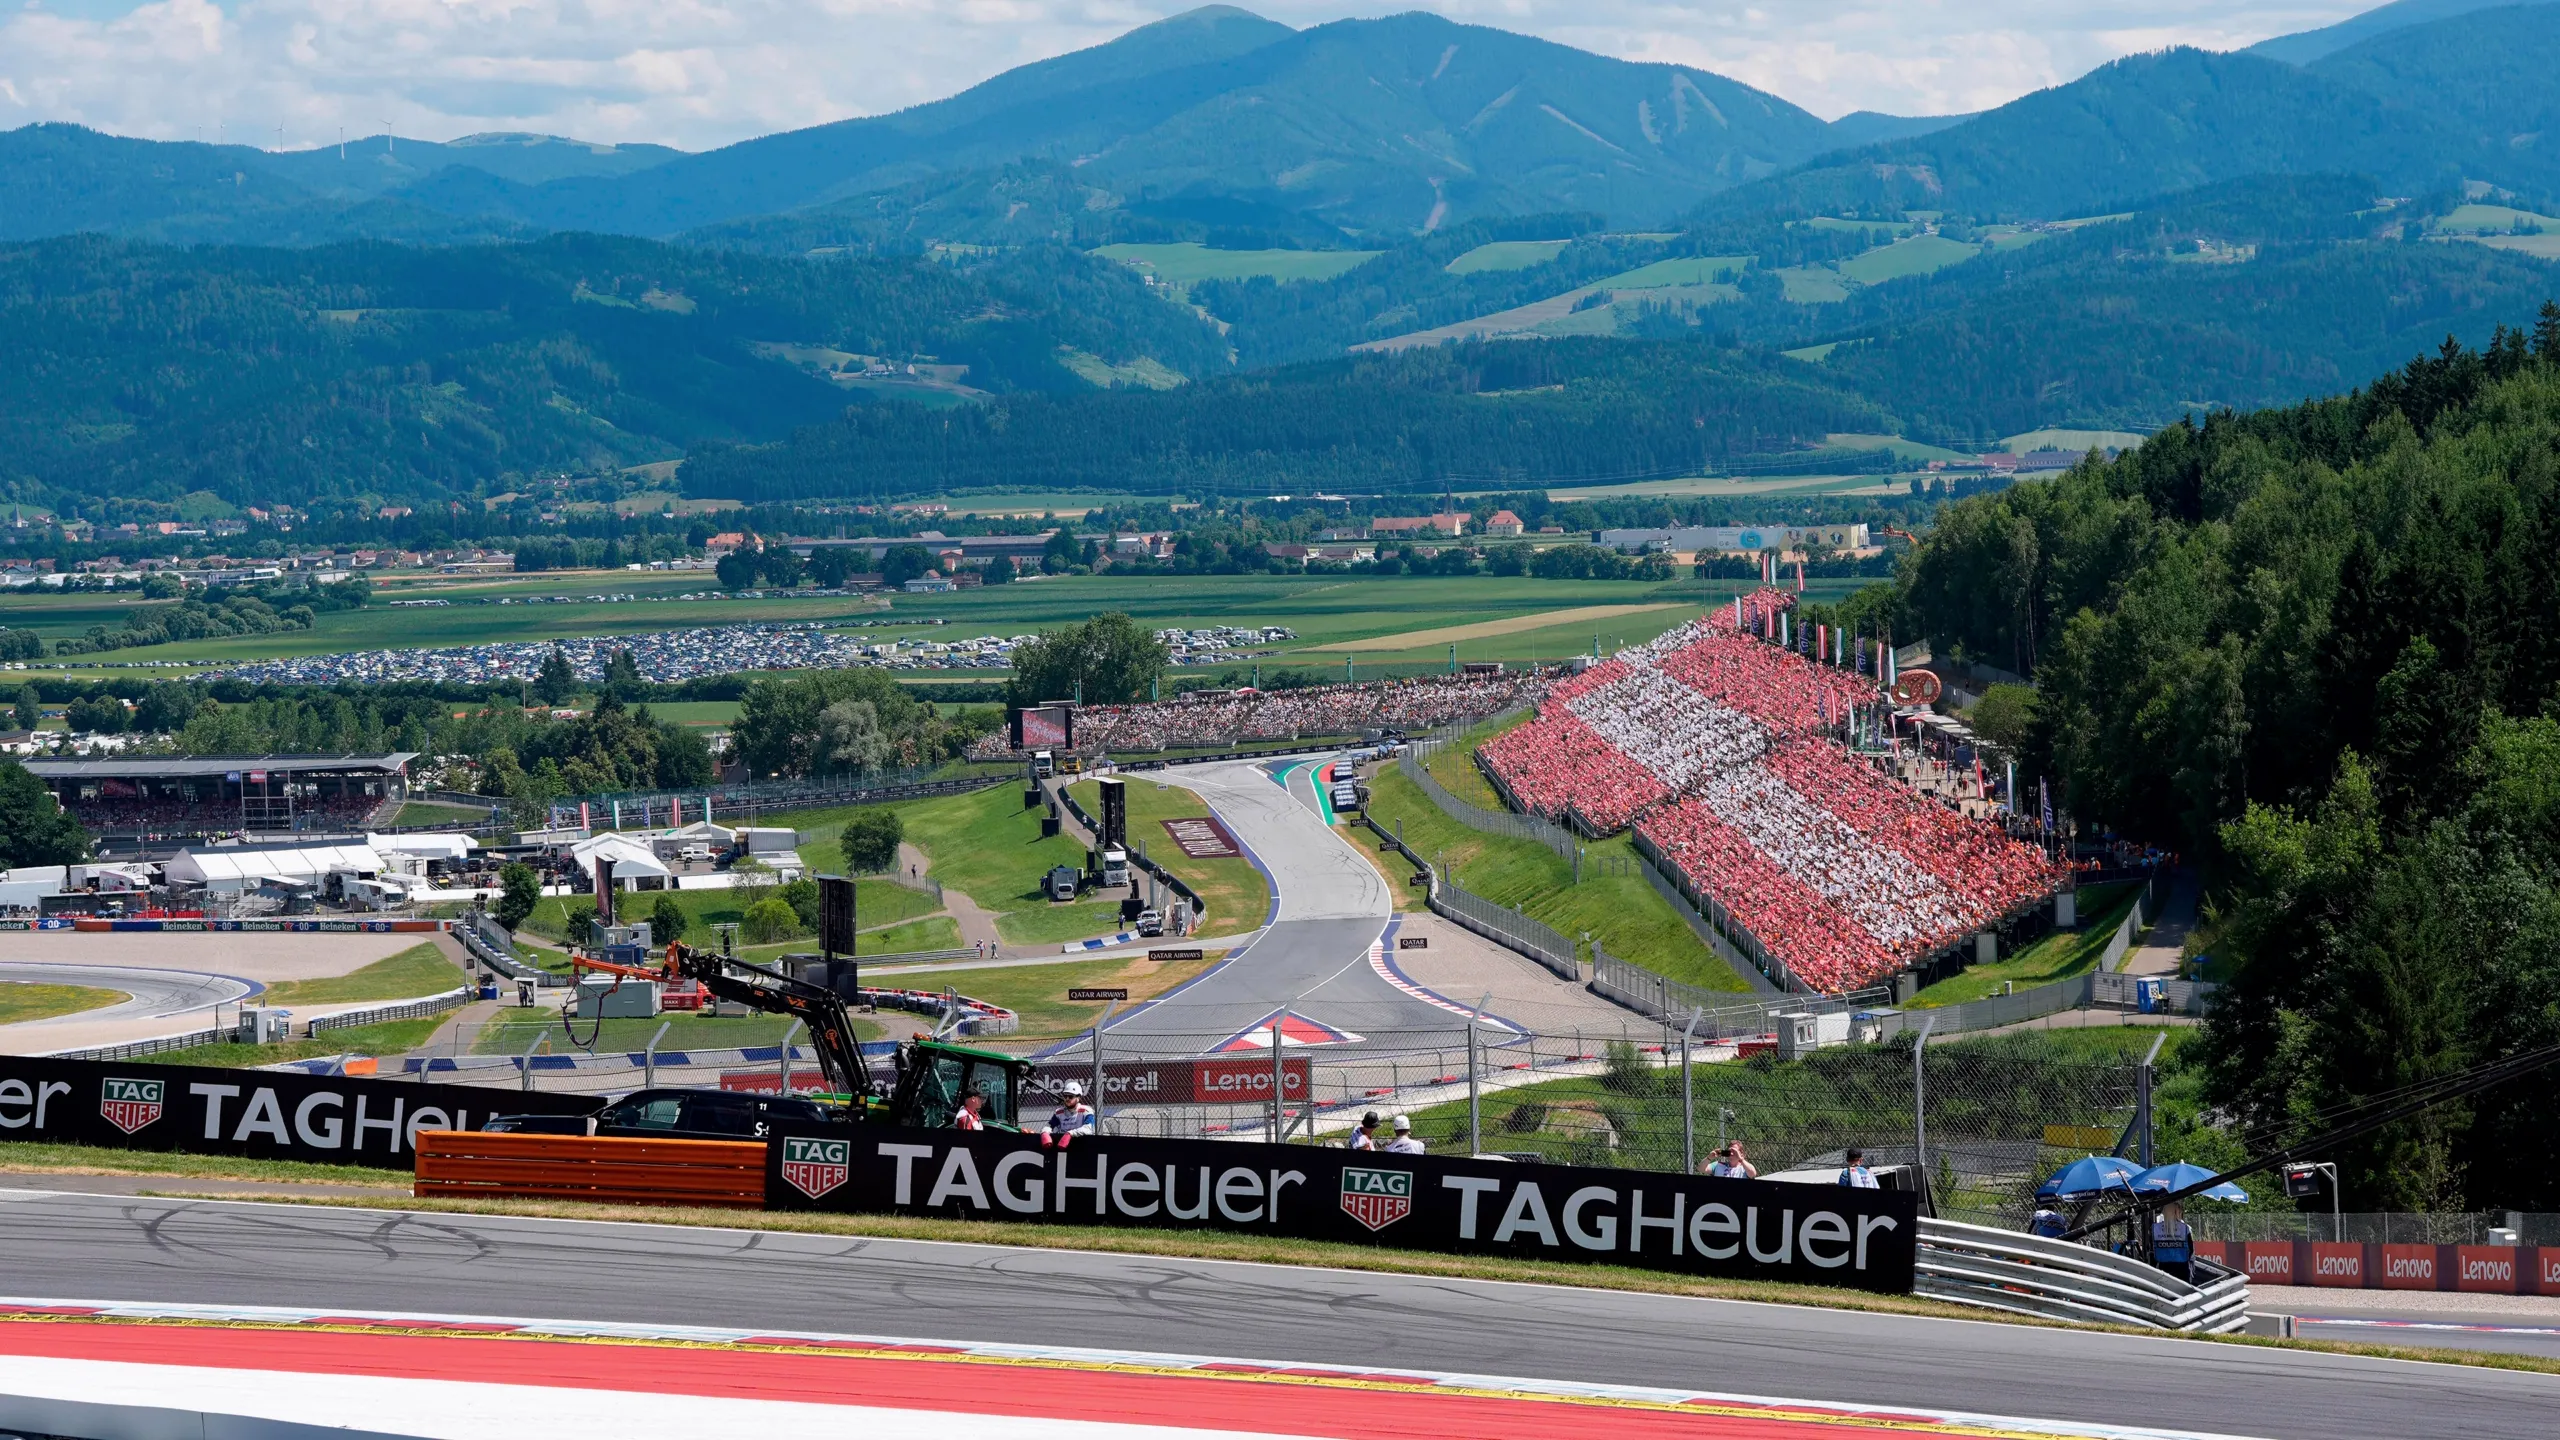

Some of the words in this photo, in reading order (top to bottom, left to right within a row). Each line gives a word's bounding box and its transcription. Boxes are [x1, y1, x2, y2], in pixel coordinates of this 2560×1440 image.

[162, 922, 203, 931] Heineken
[242, 922, 281, 931] Heineken
[320, 922, 357, 931] Heineken
[1150, 952, 1172, 960] QATAR
[1070, 991, 1094, 999] QATAR
[108, 1081, 158, 1100] TAG
[1101, 1071, 1131, 1091] for
[1135, 1071, 1158, 1091] all
[1204, 1070, 1301, 1091] Lenovo
[104, 1103, 158, 1130] HEUER
[759, 1103, 767, 1111] 11
[790, 1141, 843, 1162] TAG
[785, 1163, 846, 1194] HEUER
[1347, 1171, 1405, 1195] TAG
[1344, 1195, 1407, 1226] HEUER
[2248, 1251, 2289, 1274] Lenovo
[2316, 1252, 2358, 1276] Lenovo
[2387, 1254, 2432, 1278] Lenovo
[2462, 1255, 2511, 1281] Lenovo
